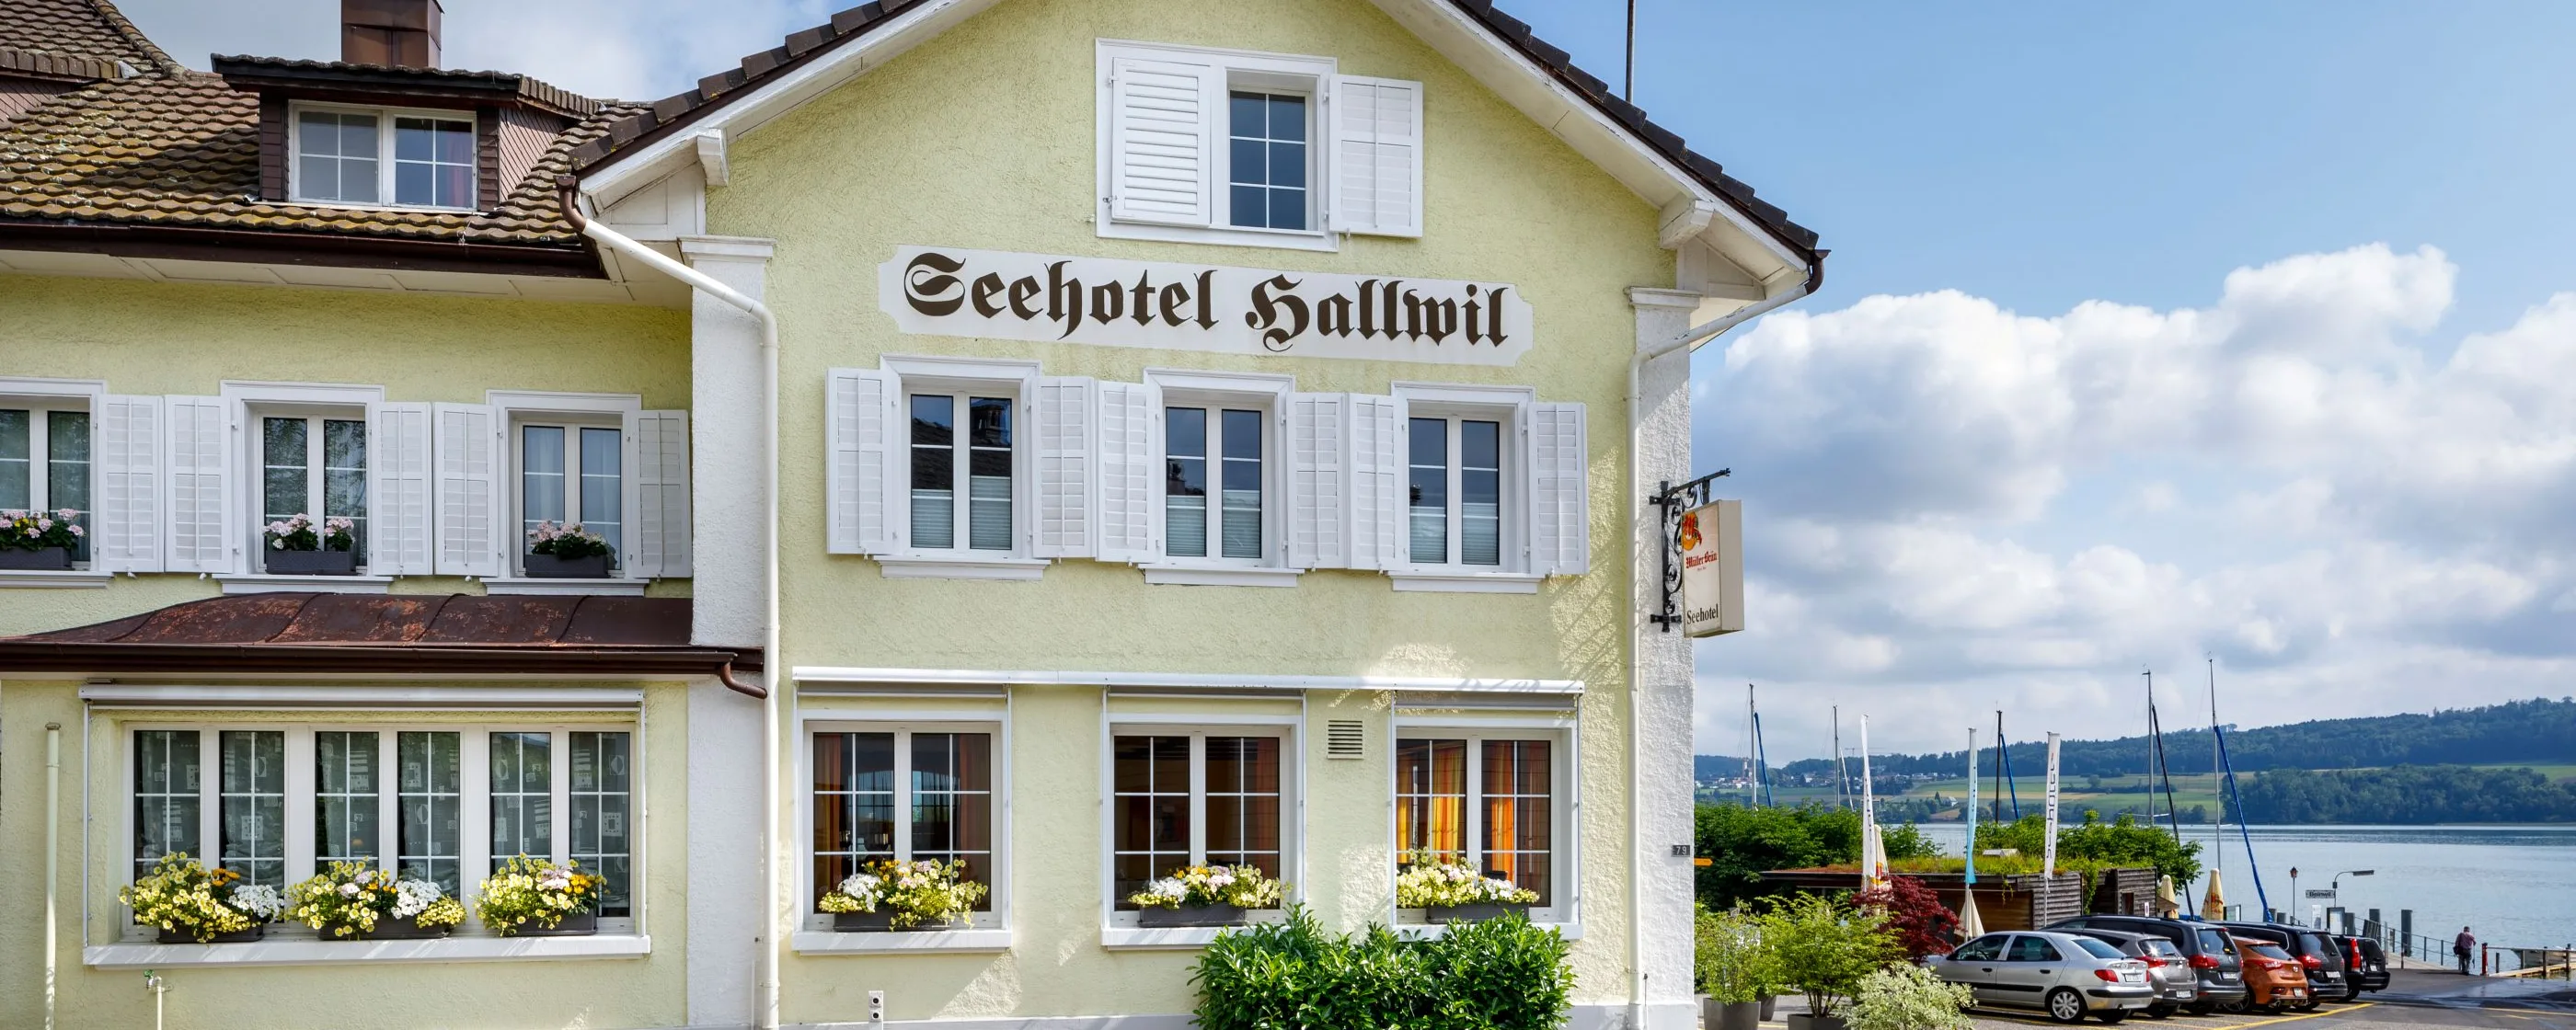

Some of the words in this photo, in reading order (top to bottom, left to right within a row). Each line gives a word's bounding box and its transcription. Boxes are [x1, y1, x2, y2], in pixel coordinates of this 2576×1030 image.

[903, 252, 1220, 340] Seehotel
[1245, 273, 1509, 352] Hallwil
[1686, 603, 1719, 624] Seehotel
[1675, 846, 1687, 855] 79
